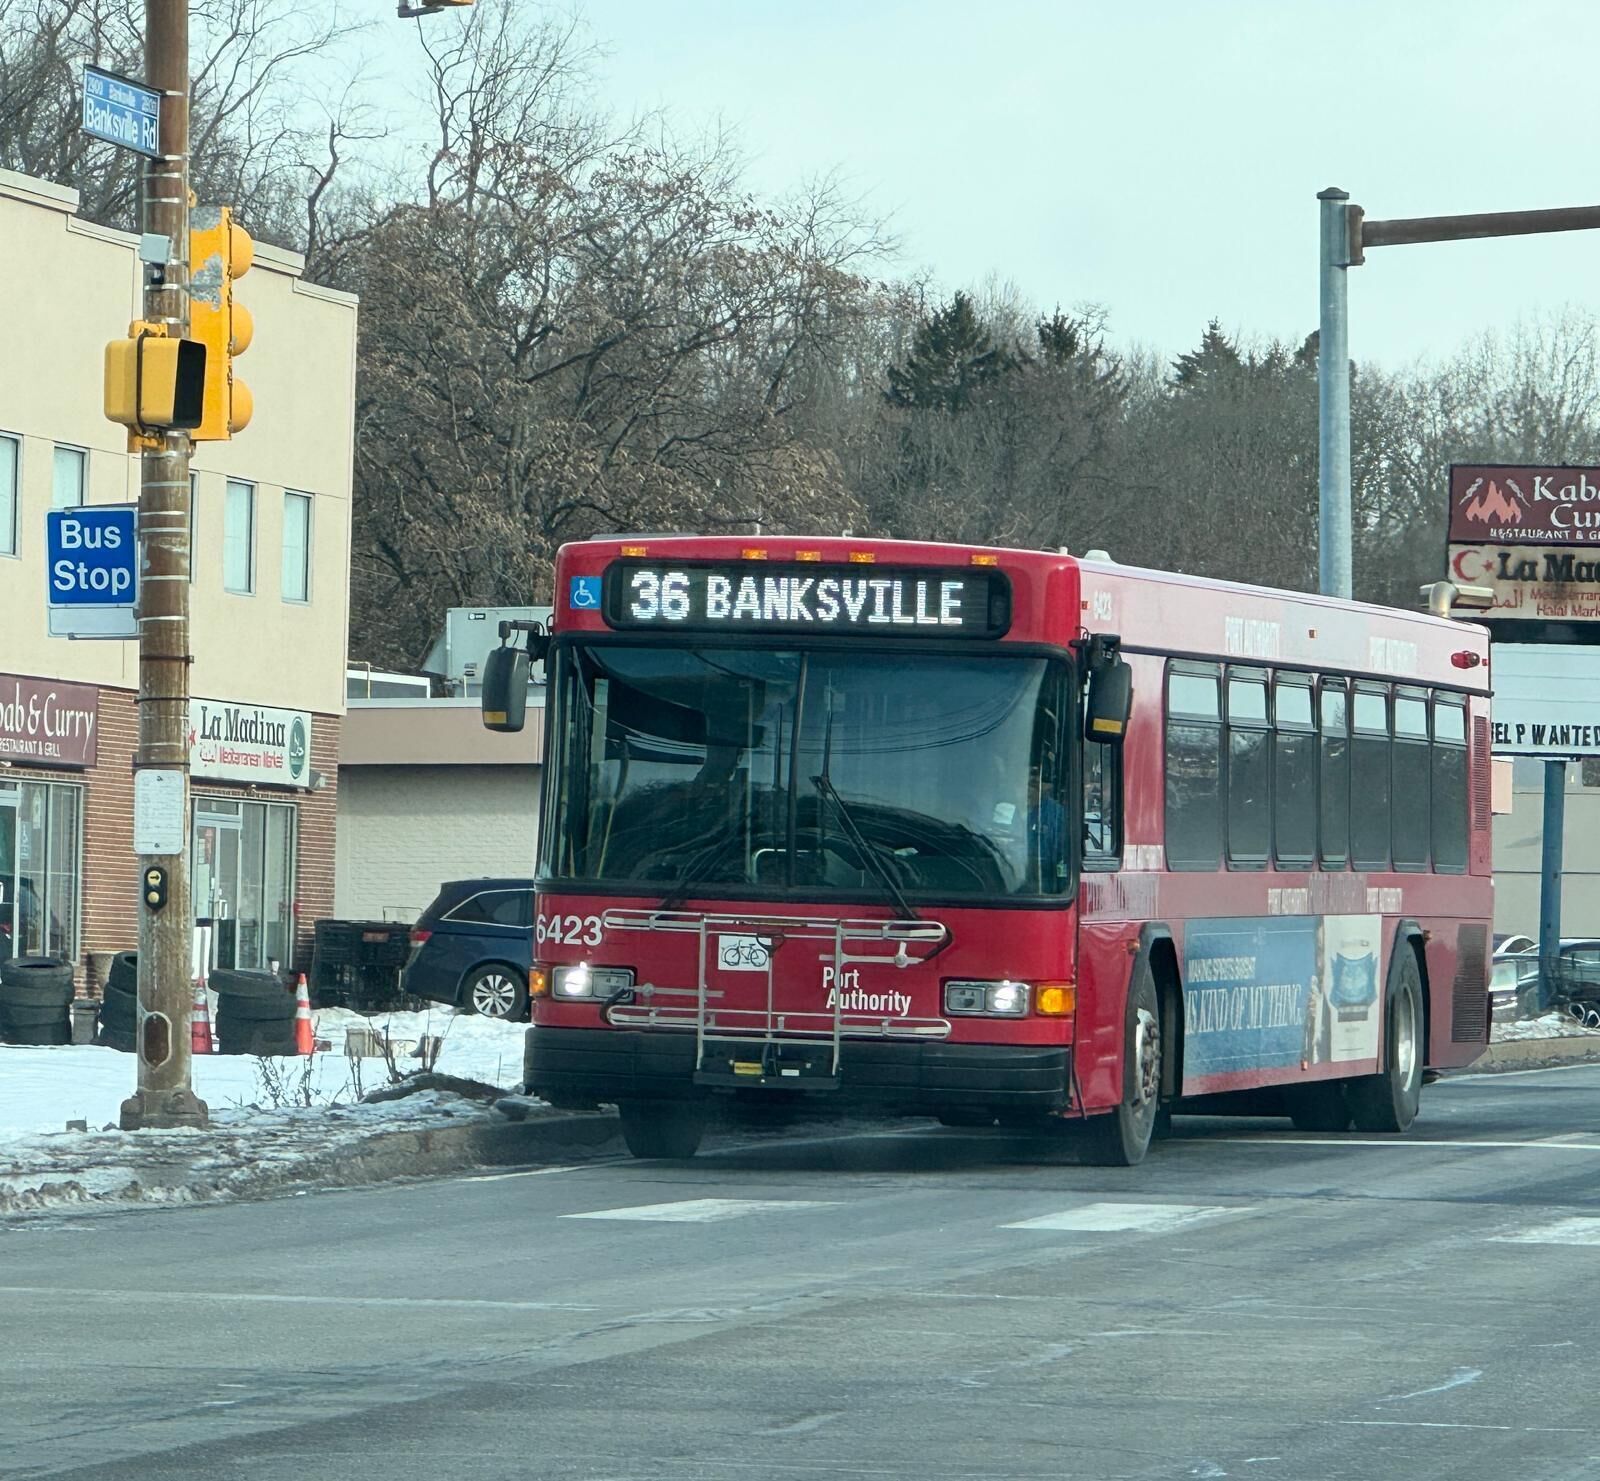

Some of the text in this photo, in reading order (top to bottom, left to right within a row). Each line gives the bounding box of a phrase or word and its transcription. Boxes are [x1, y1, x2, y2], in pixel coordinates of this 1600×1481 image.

[86, 97, 139, 144] Banksville
[142, 116, 157, 150] Rd
[1533, 474, 1600, 502] Kab
[60, 519, 122, 549] Bus
[53, 559, 131, 596] Stop
[1496, 552, 1538, 582] La
[631, 571, 964, 625] 36 BANKSVILLE
[27, 693, 41, 735] &
[43, 692, 94, 760] Curry
[200, 706, 286, 747] La Madina
[536, 913, 603, 946] 6423
[825, 988, 912, 1017] Authority
[1230, 986, 1248, 1031] OF
